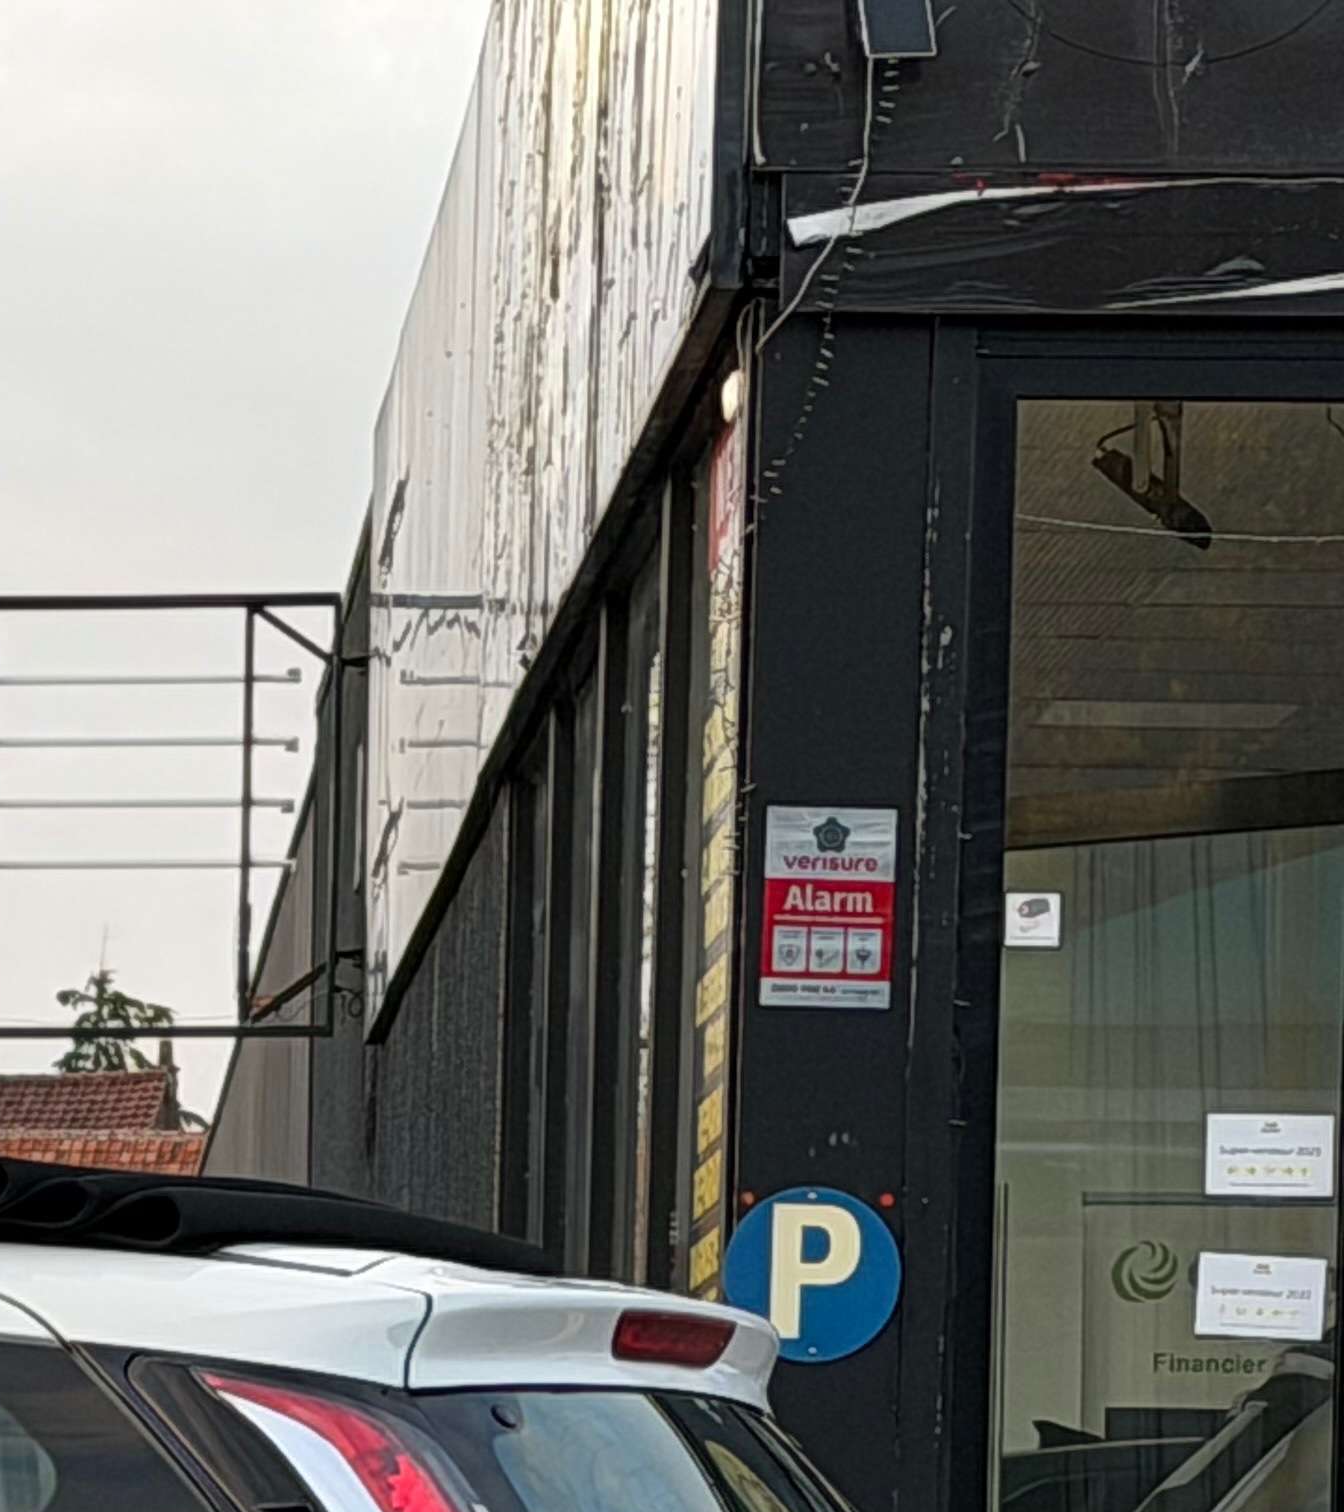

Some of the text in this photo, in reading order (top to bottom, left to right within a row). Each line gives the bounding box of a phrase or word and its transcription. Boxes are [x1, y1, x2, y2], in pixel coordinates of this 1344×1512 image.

[783, 855, 879, 872] verisure
[783, 883, 874, 913] Alarm
[770, 1203, 861, 1339] P
